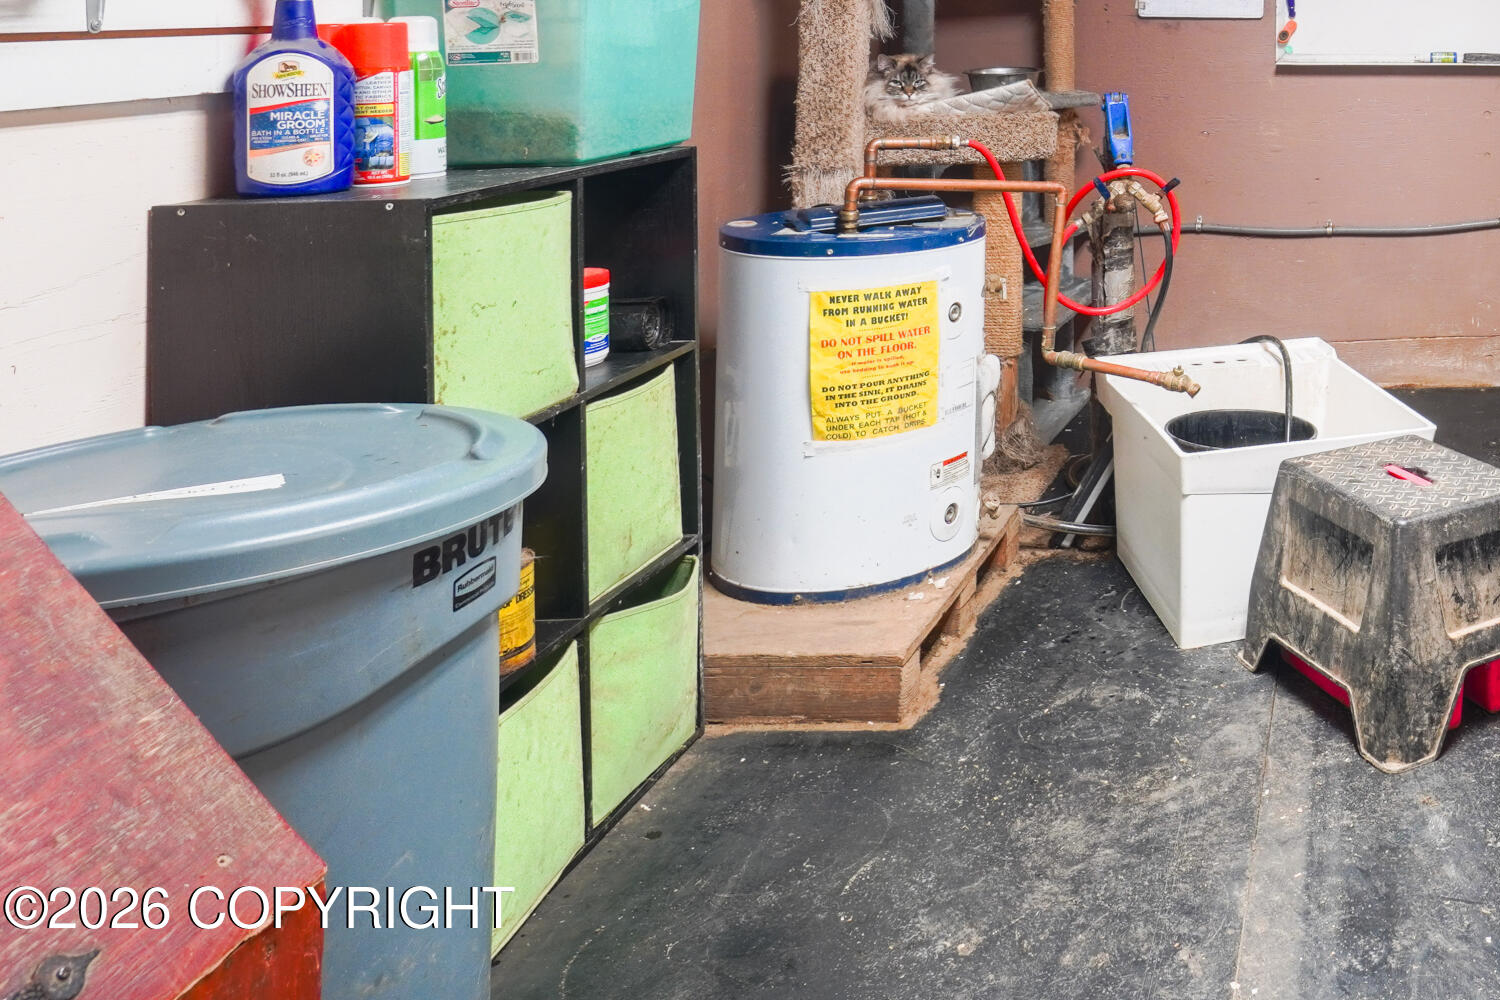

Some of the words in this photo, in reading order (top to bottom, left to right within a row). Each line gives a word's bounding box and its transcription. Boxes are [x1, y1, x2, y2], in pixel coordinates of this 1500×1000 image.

[252, 82, 327, 98] SHOWSHEEN
[270, 111, 325, 121] MIRACLE
[277, 119, 326, 129] GROOM
[293, 127, 325, 135] BOTTLE
[829, 294, 859, 304] NEVER
[863, 291, 891, 301] WALK
[895, 286, 922, 297] AWAY
[823, 307, 848, 317] FROM
[853, 303, 894, 314] RUNNING
[898, 297, 928, 309] WATER
[845, 319, 855, 327] IN
[871, 313, 909, 325] BUCKET!
[821, 339, 836, 348] DO
[841, 336, 862, 346] NOT
[865, 333, 894, 344] SPILL
[898, 326, 931, 339] WATER
[837, 350, 852, 360] ON
[857, 348, 875, 357] THE
[879, 342, 917, 355] FLOOR.
[837, 383, 858, 391] NOT
[862, 379, 885, 389] POUR
[887, 370, 930, 385] ANYTHING
[836, 392, 857, 400] THE
[858, 388, 884, 398] SINK,
[896, 380, 927, 392] DRAINS
[834, 401, 857, 409] INTO
[859, 398, 879, 407] THE
[880, 391, 920, 403] GROUND.
[826, 414, 860, 423] ALWAYS
[866, 411, 881, 419] PUT
[897, 402, 927, 414] BUCKET
[826, 423, 855, 432] UNDER
[858, 419, 881, 428] EACH
[885, 416, 900, 424] TAP
[903, 412, 920, 423] (HOT
[825, 430, 852, 440] COLD)
[855, 430, 866, 438] TO
[873, 425, 900, 435] CATCH
[457, 565, 494, 593] Rubbermaid
